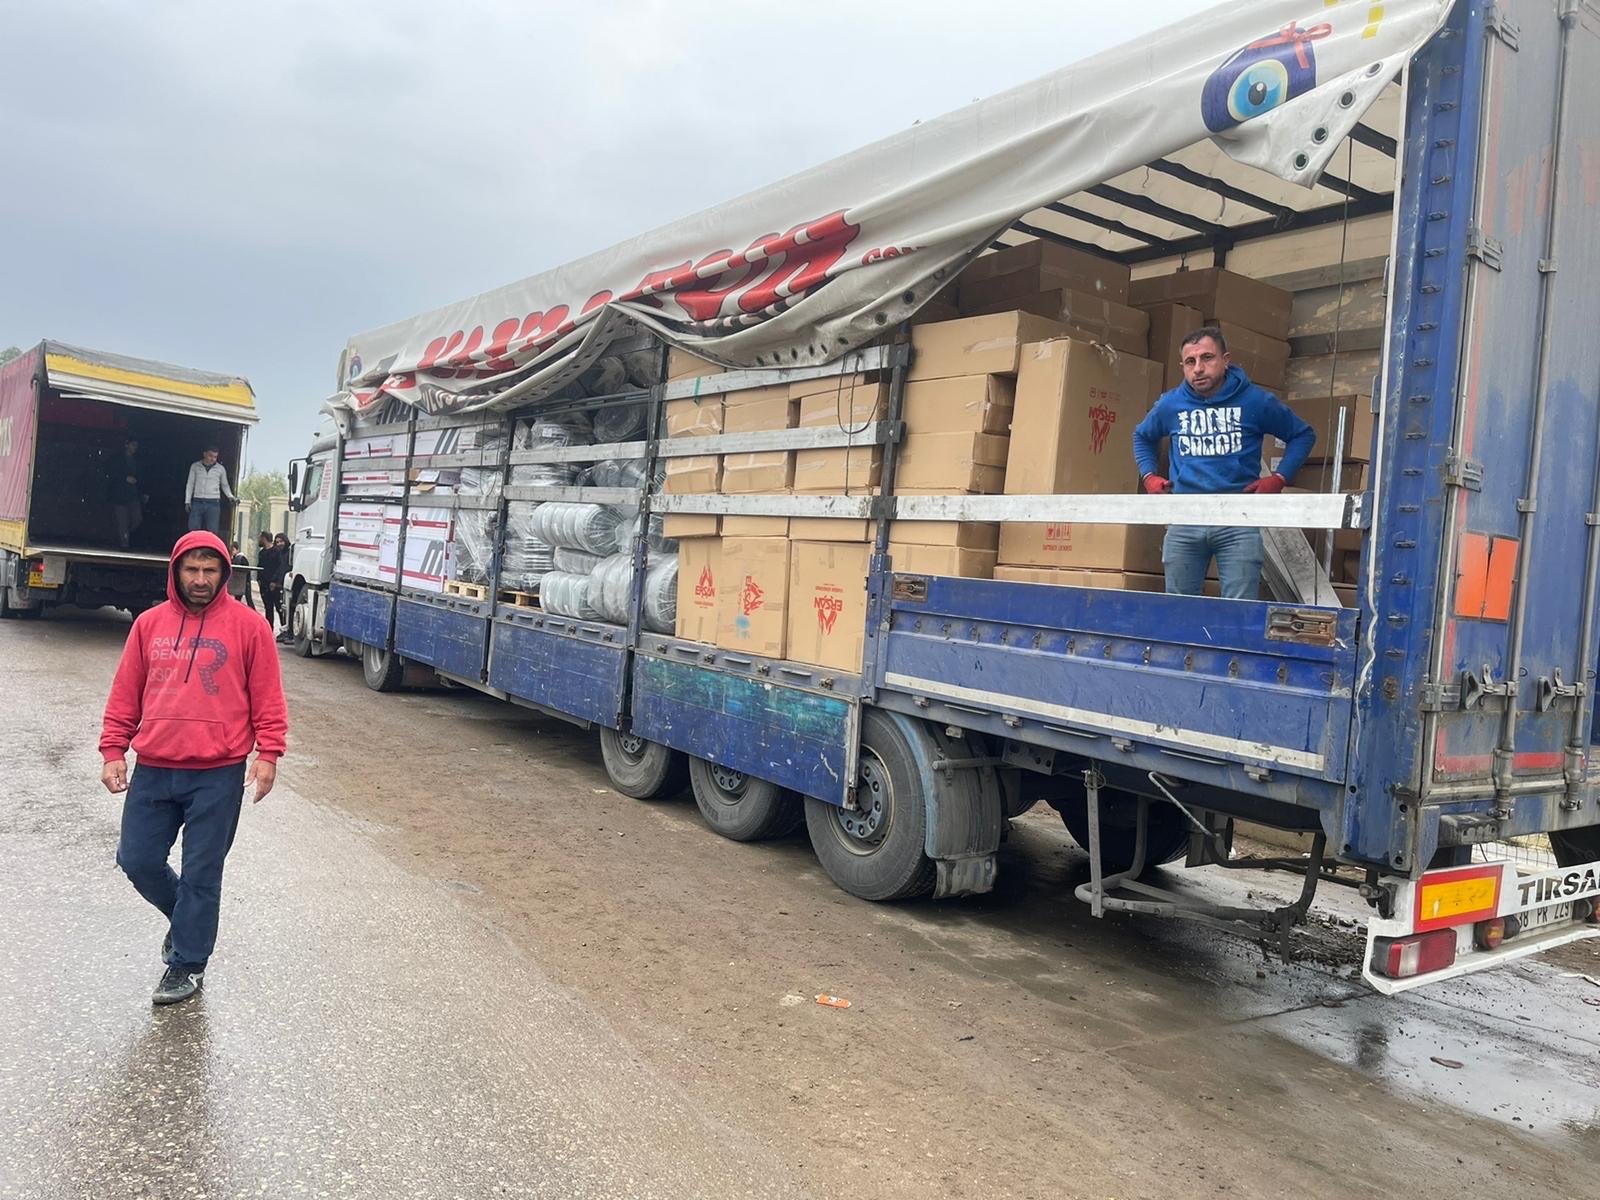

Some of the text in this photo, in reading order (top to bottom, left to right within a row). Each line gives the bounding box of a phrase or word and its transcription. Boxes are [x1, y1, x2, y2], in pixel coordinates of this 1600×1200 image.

[151, 636, 187, 647] RAW
[150, 649, 199, 660] DENIM
[1517, 868, 1600, 907] TIRSA
